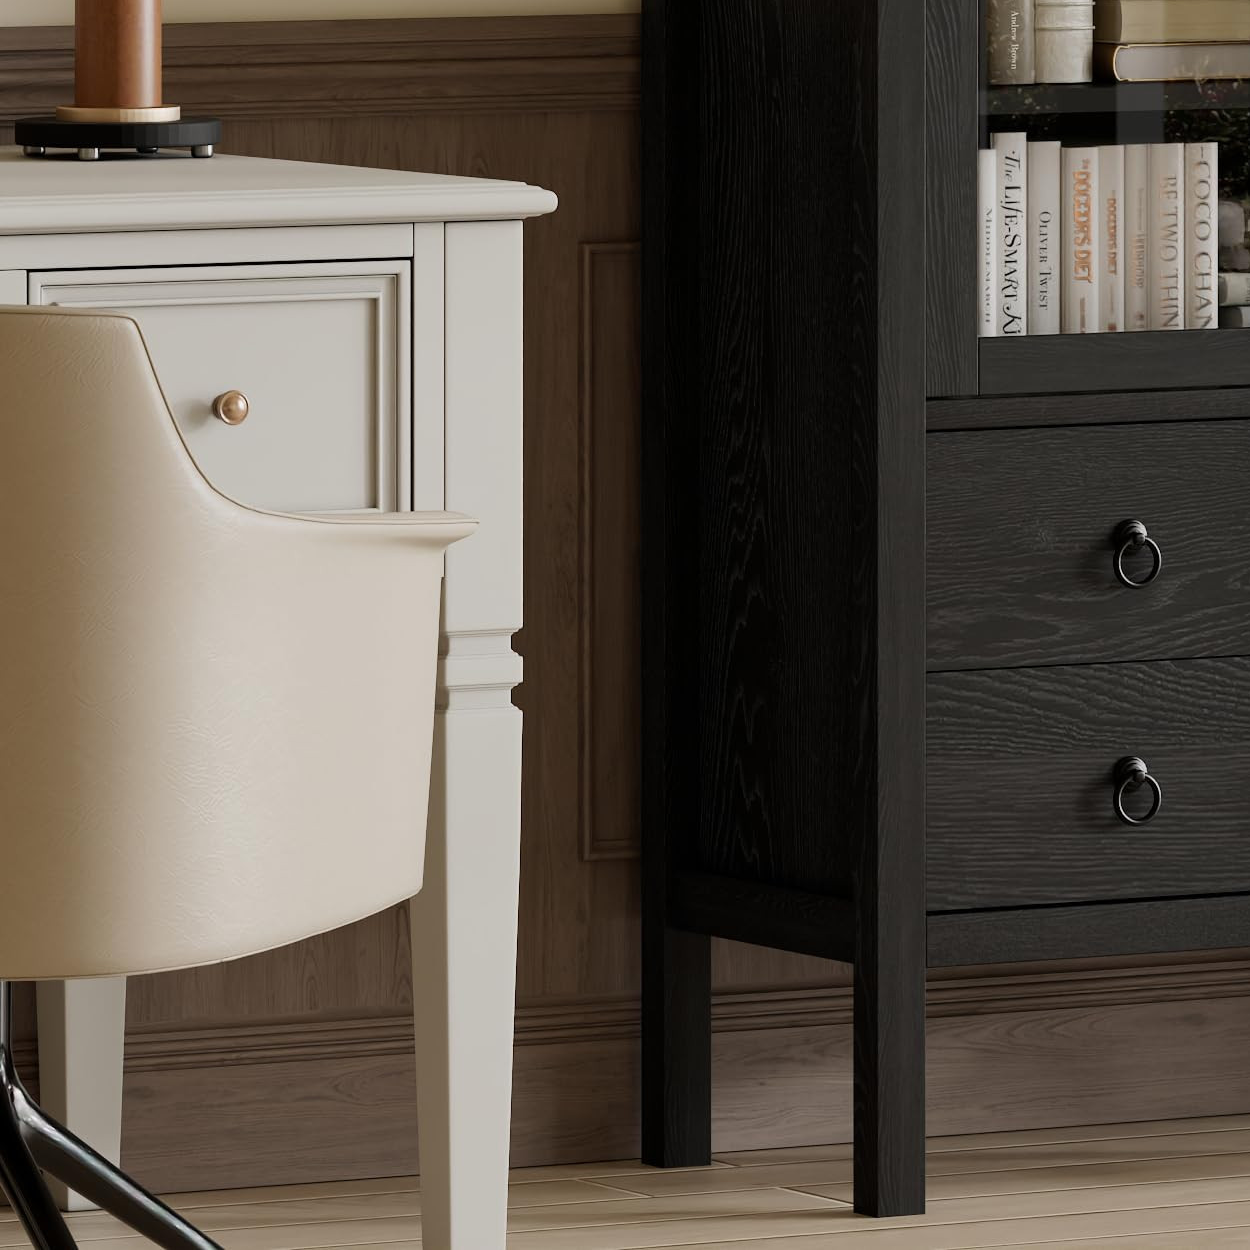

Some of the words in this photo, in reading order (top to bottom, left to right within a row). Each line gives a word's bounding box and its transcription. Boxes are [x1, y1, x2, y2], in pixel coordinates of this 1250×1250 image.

[1011, 11, 1020, 40] Andrew
[1011, 43, 1020, 70] Brown
[1039, 211, 1051, 263] OLIVER
[1161, 205, 1178, 262] TWO
[1073, 250, 1092, 283] DIET
[1039, 265, 1052, 310] TWIST
